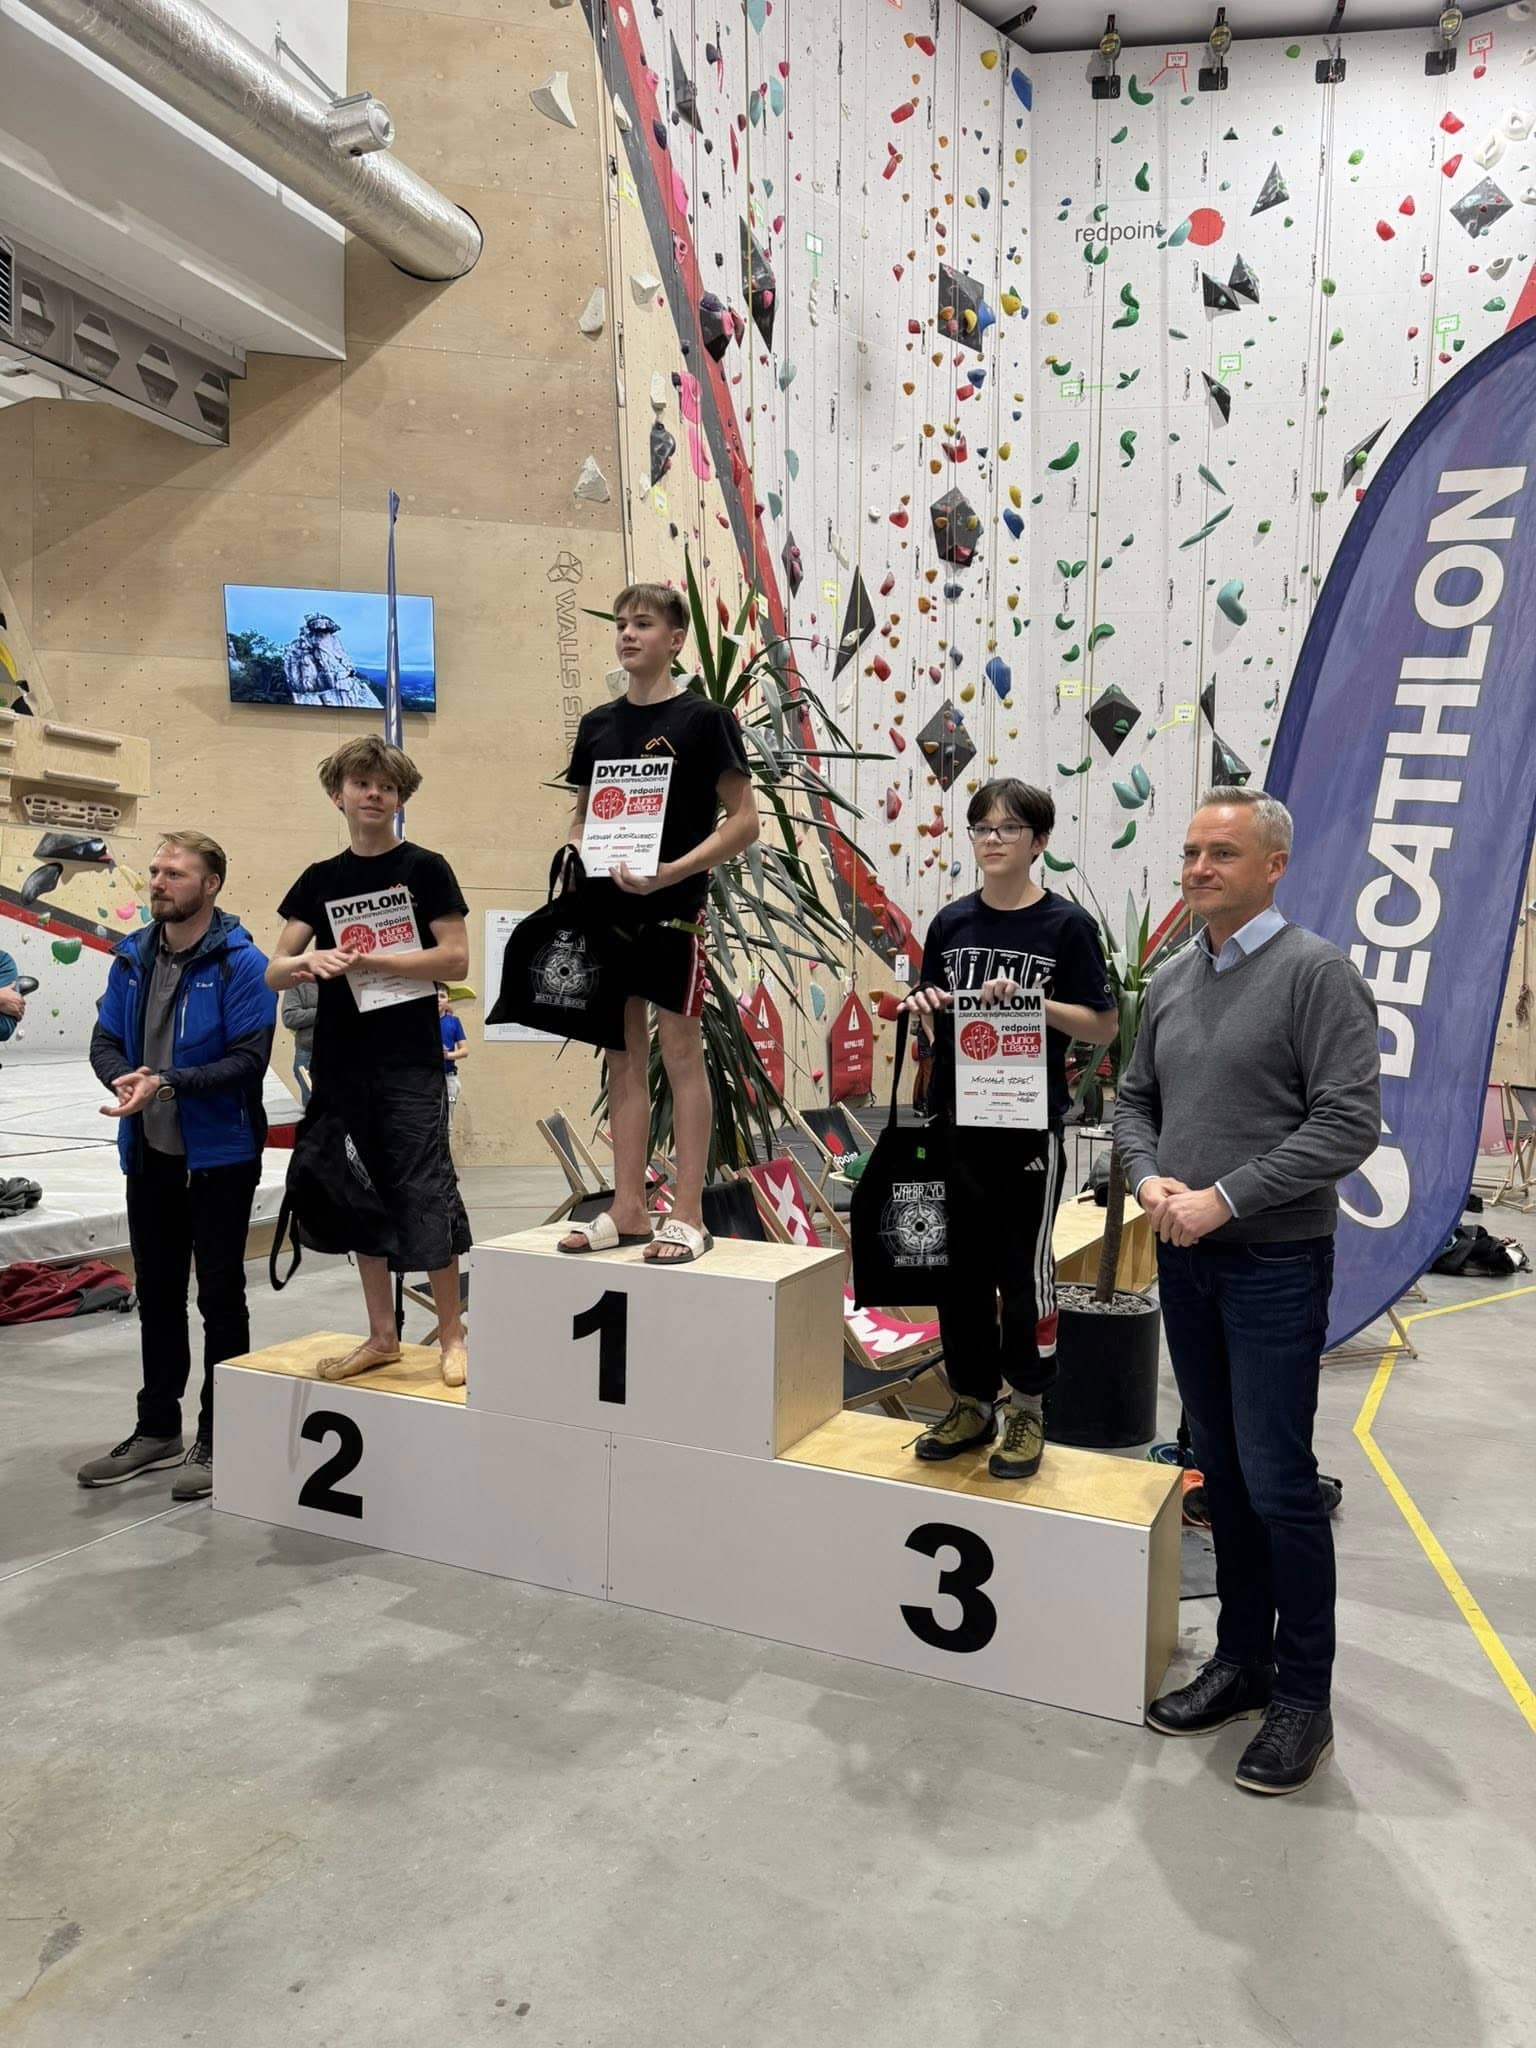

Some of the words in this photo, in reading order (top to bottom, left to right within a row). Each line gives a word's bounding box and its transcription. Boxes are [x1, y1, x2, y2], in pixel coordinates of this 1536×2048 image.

[555, 588, 581, 689] WALLS
[597, 763, 669, 778] DYPLOM
[1350, 466, 1527, 1078] DECATHLON
[629, 786, 664, 795] redpoint
[331, 892, 407, 919] DYPLOM
[375, 915, 410, 928] redpoint
[1001, 1024, 1040, 1032] redpoint
[1003, 1043, 1040, 1054] League
[1007, 1034, 1036, 1045] Junior
[573, 1290, 628, 1405] 1
[298, 1410, 363, 1520] 2
[900, 1523, 998, 1653] 3
